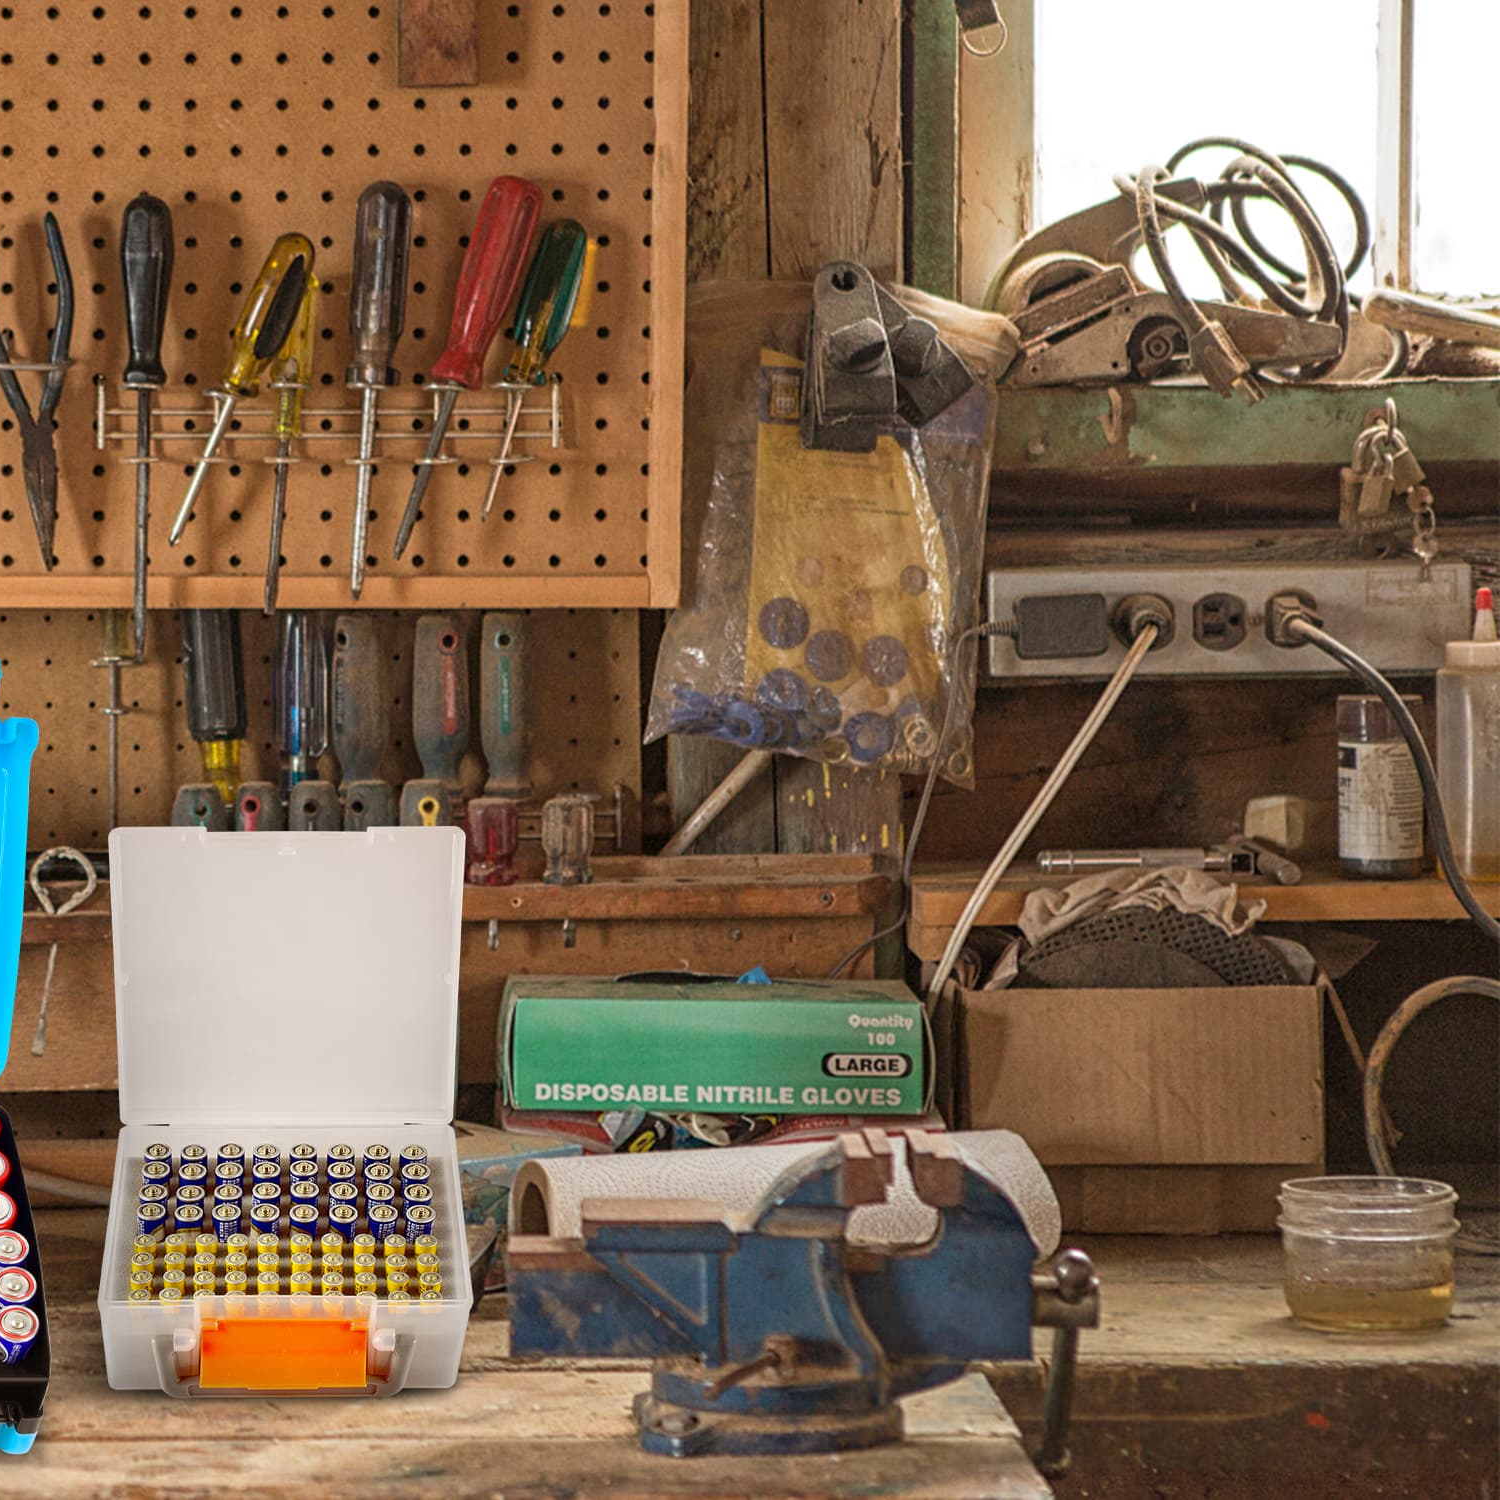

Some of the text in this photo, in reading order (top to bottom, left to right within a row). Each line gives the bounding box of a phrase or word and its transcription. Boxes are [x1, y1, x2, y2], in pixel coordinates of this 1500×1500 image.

[848, 1014, 914, 1030] Quantity
[868, 1032, 896, 1046] 100
[834, 1058, 901, 1073] LARGE
[535, 1083, 902, 1106] DISPOSABLE NITRILE GLOVES
